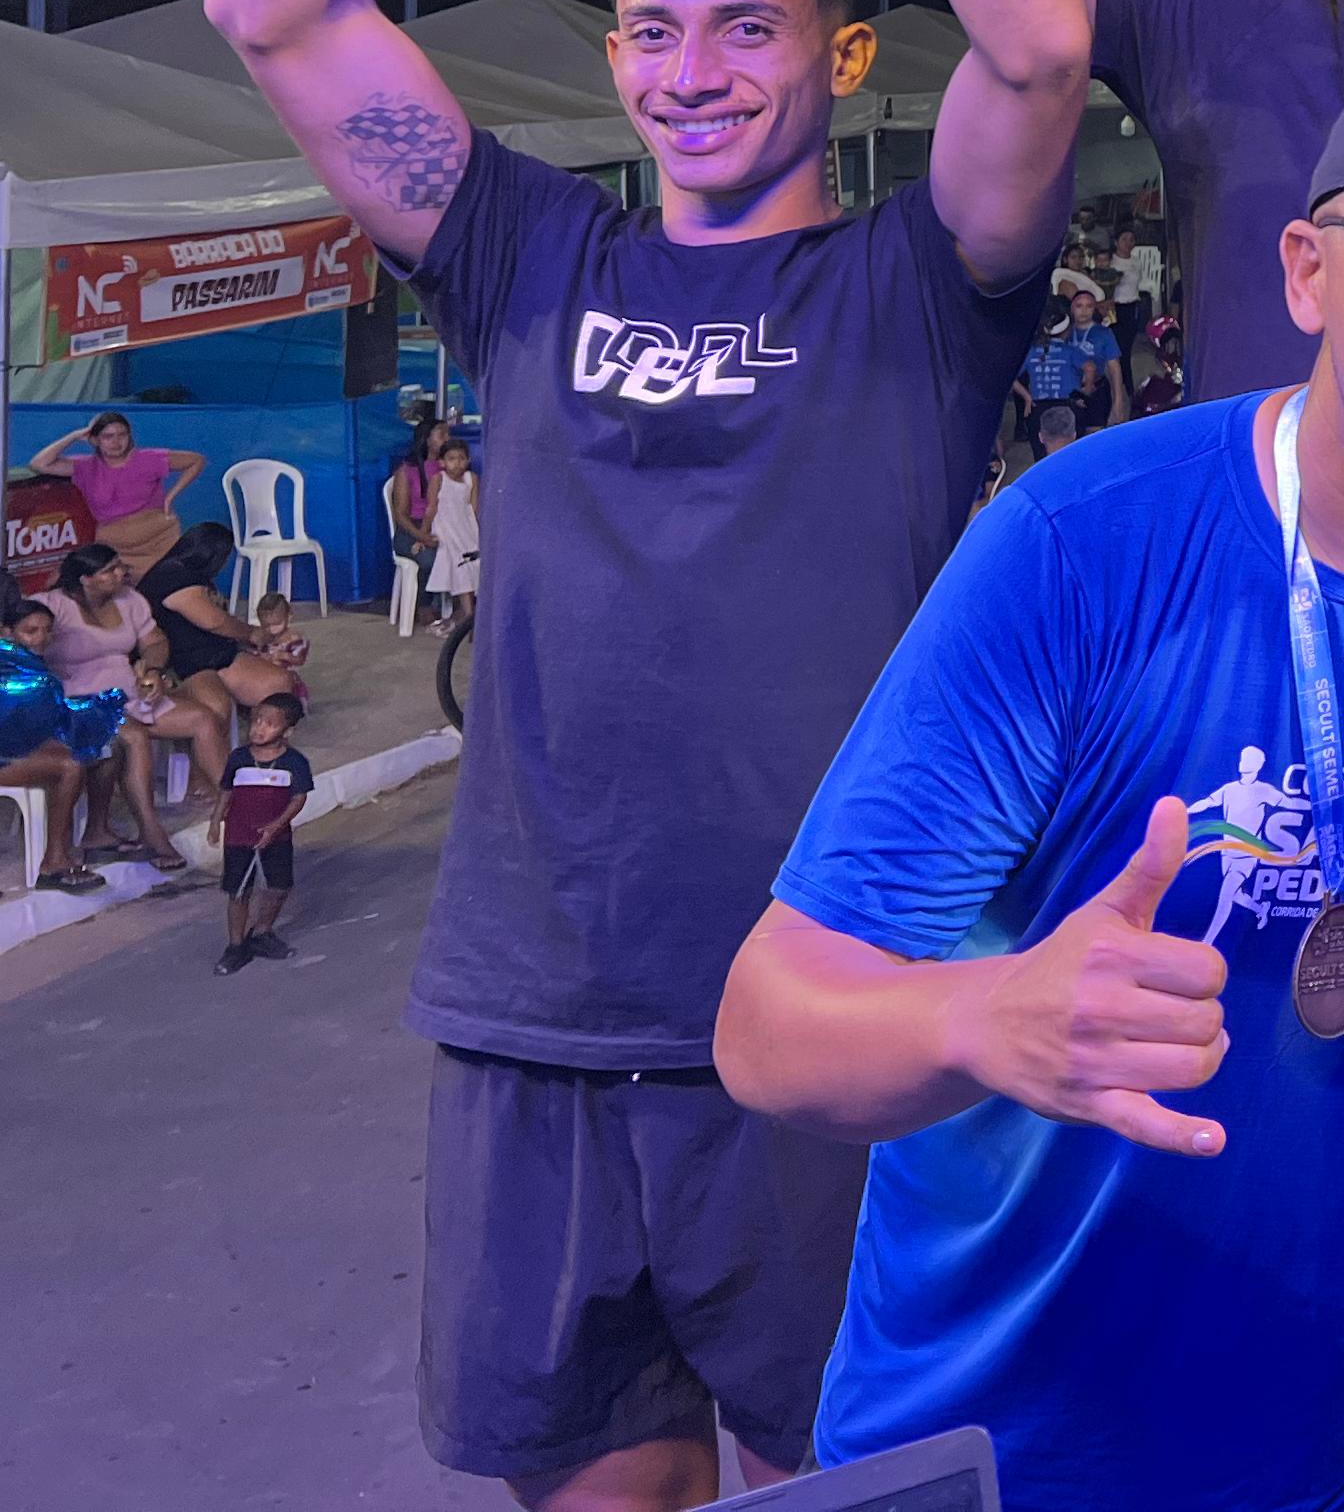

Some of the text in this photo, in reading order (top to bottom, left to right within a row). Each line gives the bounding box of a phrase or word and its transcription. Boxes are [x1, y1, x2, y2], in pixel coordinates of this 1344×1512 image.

[169, 230, 286, 268] BARRACA DO
[172, 269, 280, 312] PASSARIM
[6, 519, 78, 558] TORIA
[1314, 678, 1336, 744] SECULT
[1271, 906, 1306, 918] CORRIDA
